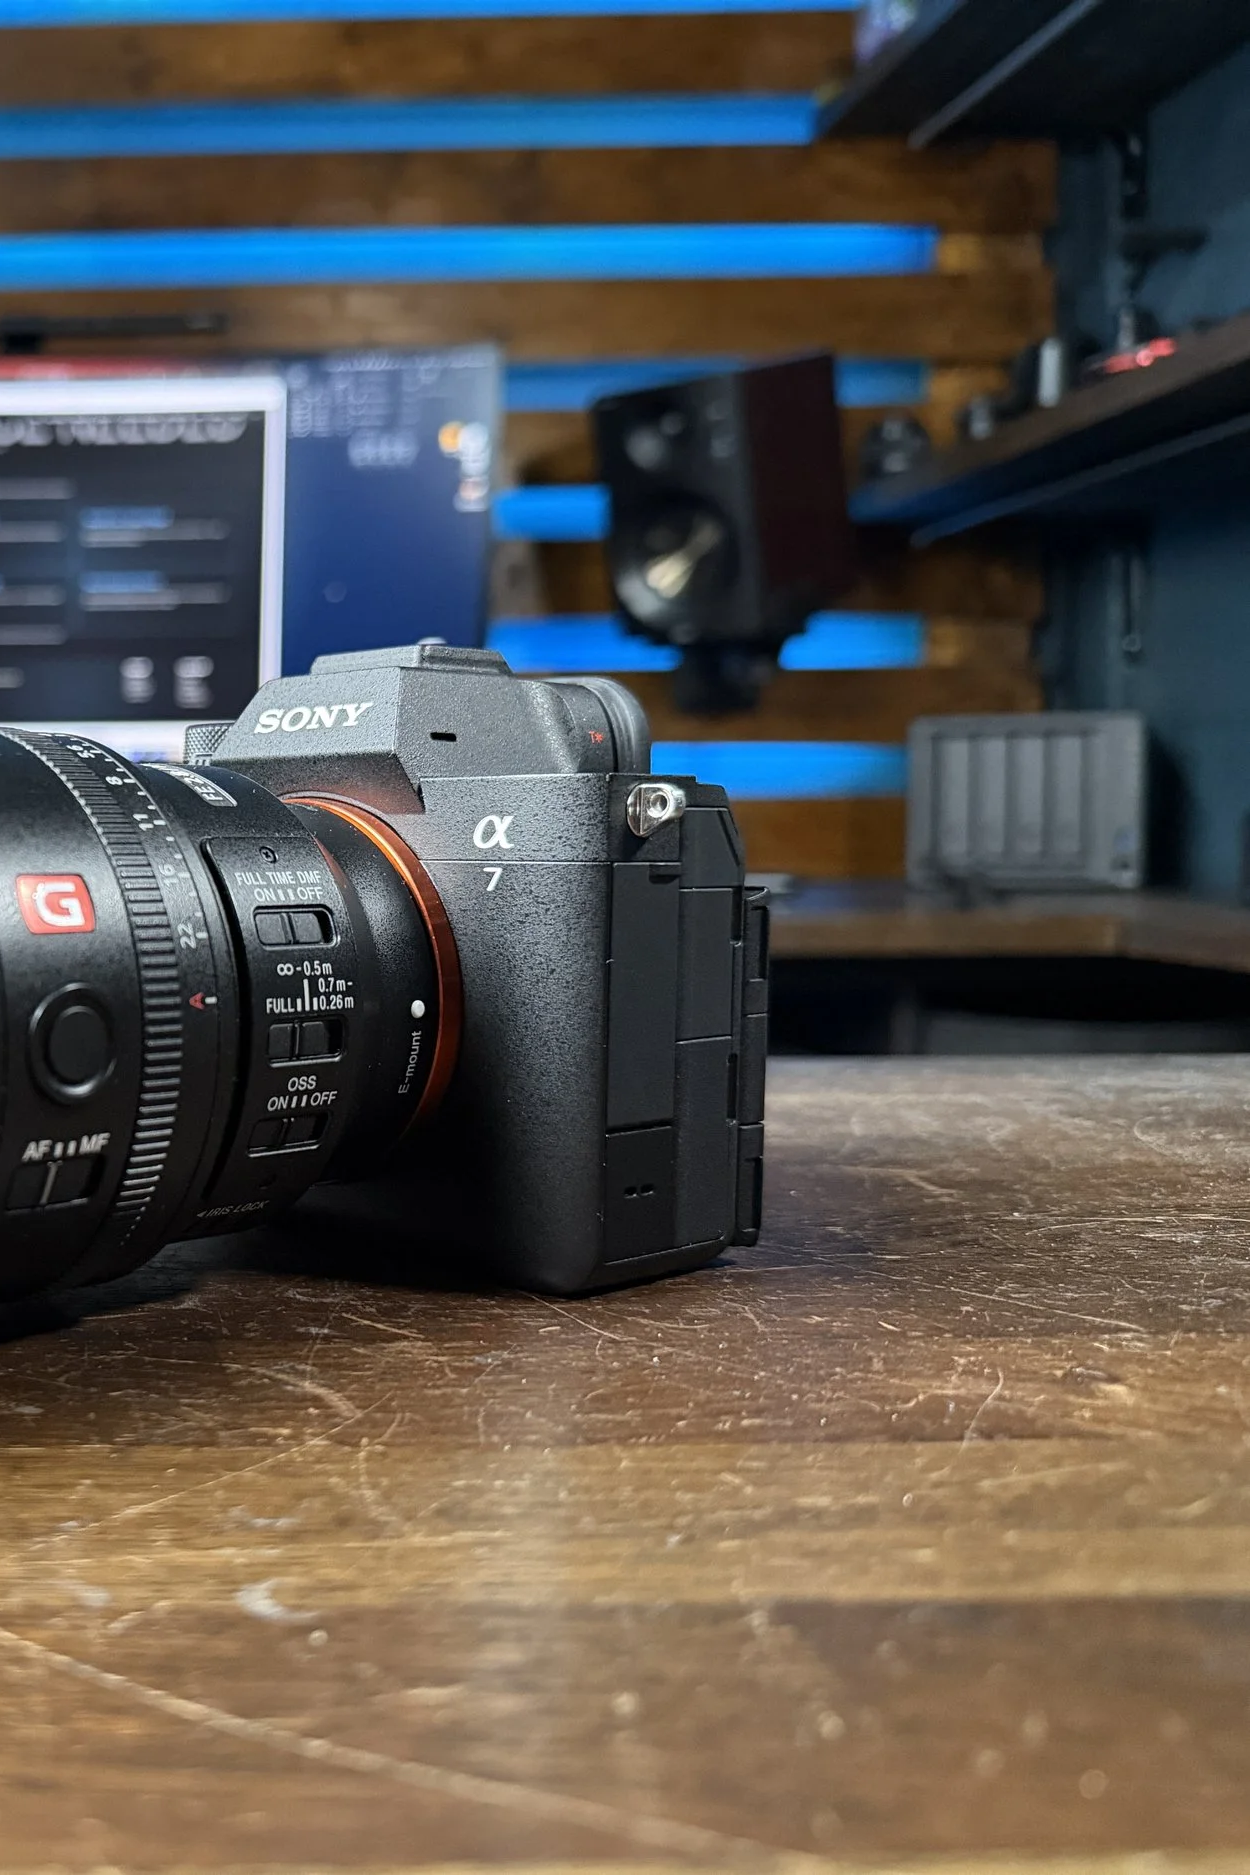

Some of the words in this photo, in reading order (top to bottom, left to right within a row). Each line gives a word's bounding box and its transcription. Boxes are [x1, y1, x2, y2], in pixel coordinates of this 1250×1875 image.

[253, 702, 374, 735] SONY
[193, 785, 224, 801] FE
[132, 813, 154, 831] 11
[472, 814, 515, 850] α
[158, 864, 180, 887] 16
[235, 871, 267, 886] FULL
[269, 871, 295, 885] TIME
[297, 871, 322, 885] DMF
[483, 867, 503, 892] 7
[33, 881, 86, 927] G
[254, 887, 276, 902] ON
[297, 886, 324, 900] OFF
[177, 922, 197, 950] 22
[266, 997, 295, 1014] FULL
[319, 994, 354, 1011] 0.26m
[397, 1030, 422, 1094] E-mount
[287, 1075, 317, 1092] OSS
[267, 1095, 289, 1111] ON
[310, 1091, 338, 1106] OFF
[21, 1140, 52, 1162] AF
[77, 1132, 111, 1155] MF
